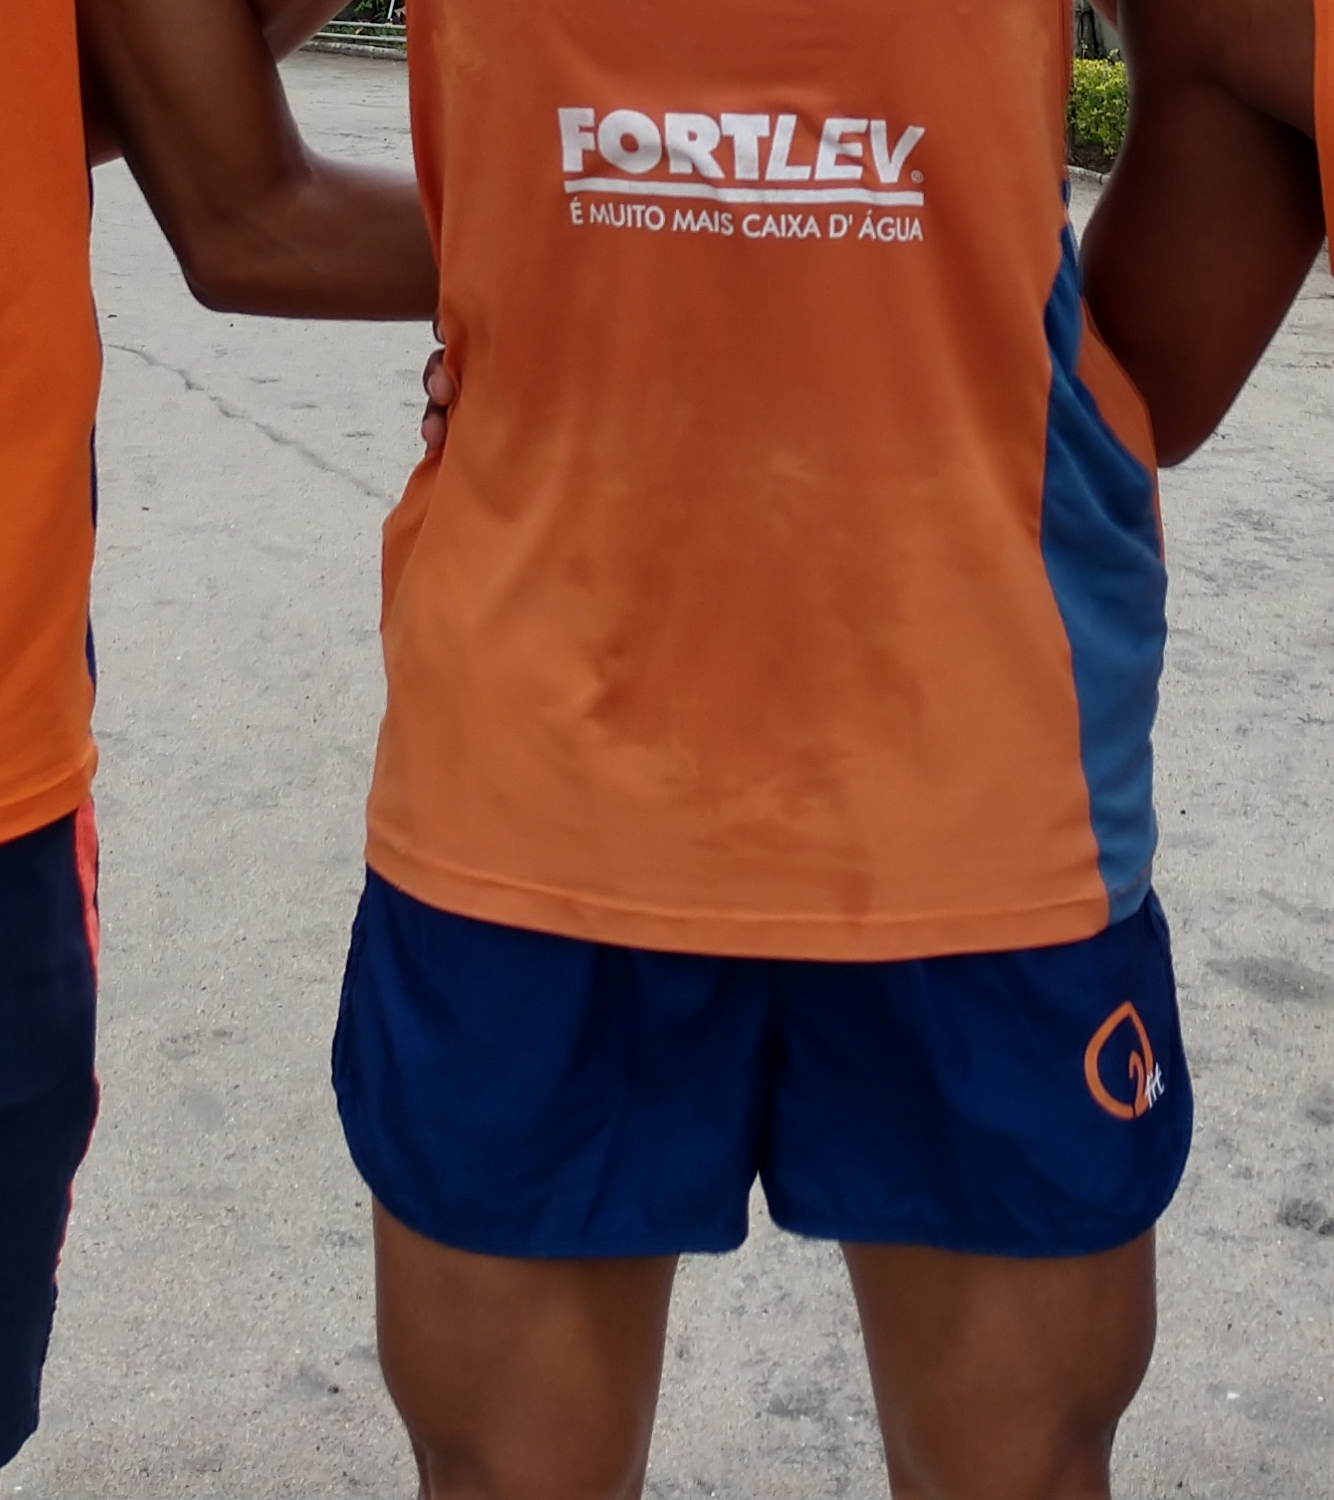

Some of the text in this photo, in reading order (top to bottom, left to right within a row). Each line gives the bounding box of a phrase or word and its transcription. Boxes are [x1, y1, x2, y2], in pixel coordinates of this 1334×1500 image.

[570, 196, 584, 225] É
[589, 202, 666, 232] MUITO
[672, 209, 735, 236] MAIS
[741, 213, 822, 239] CAIXA
[858, 209, 923, 242] ÁGUA
